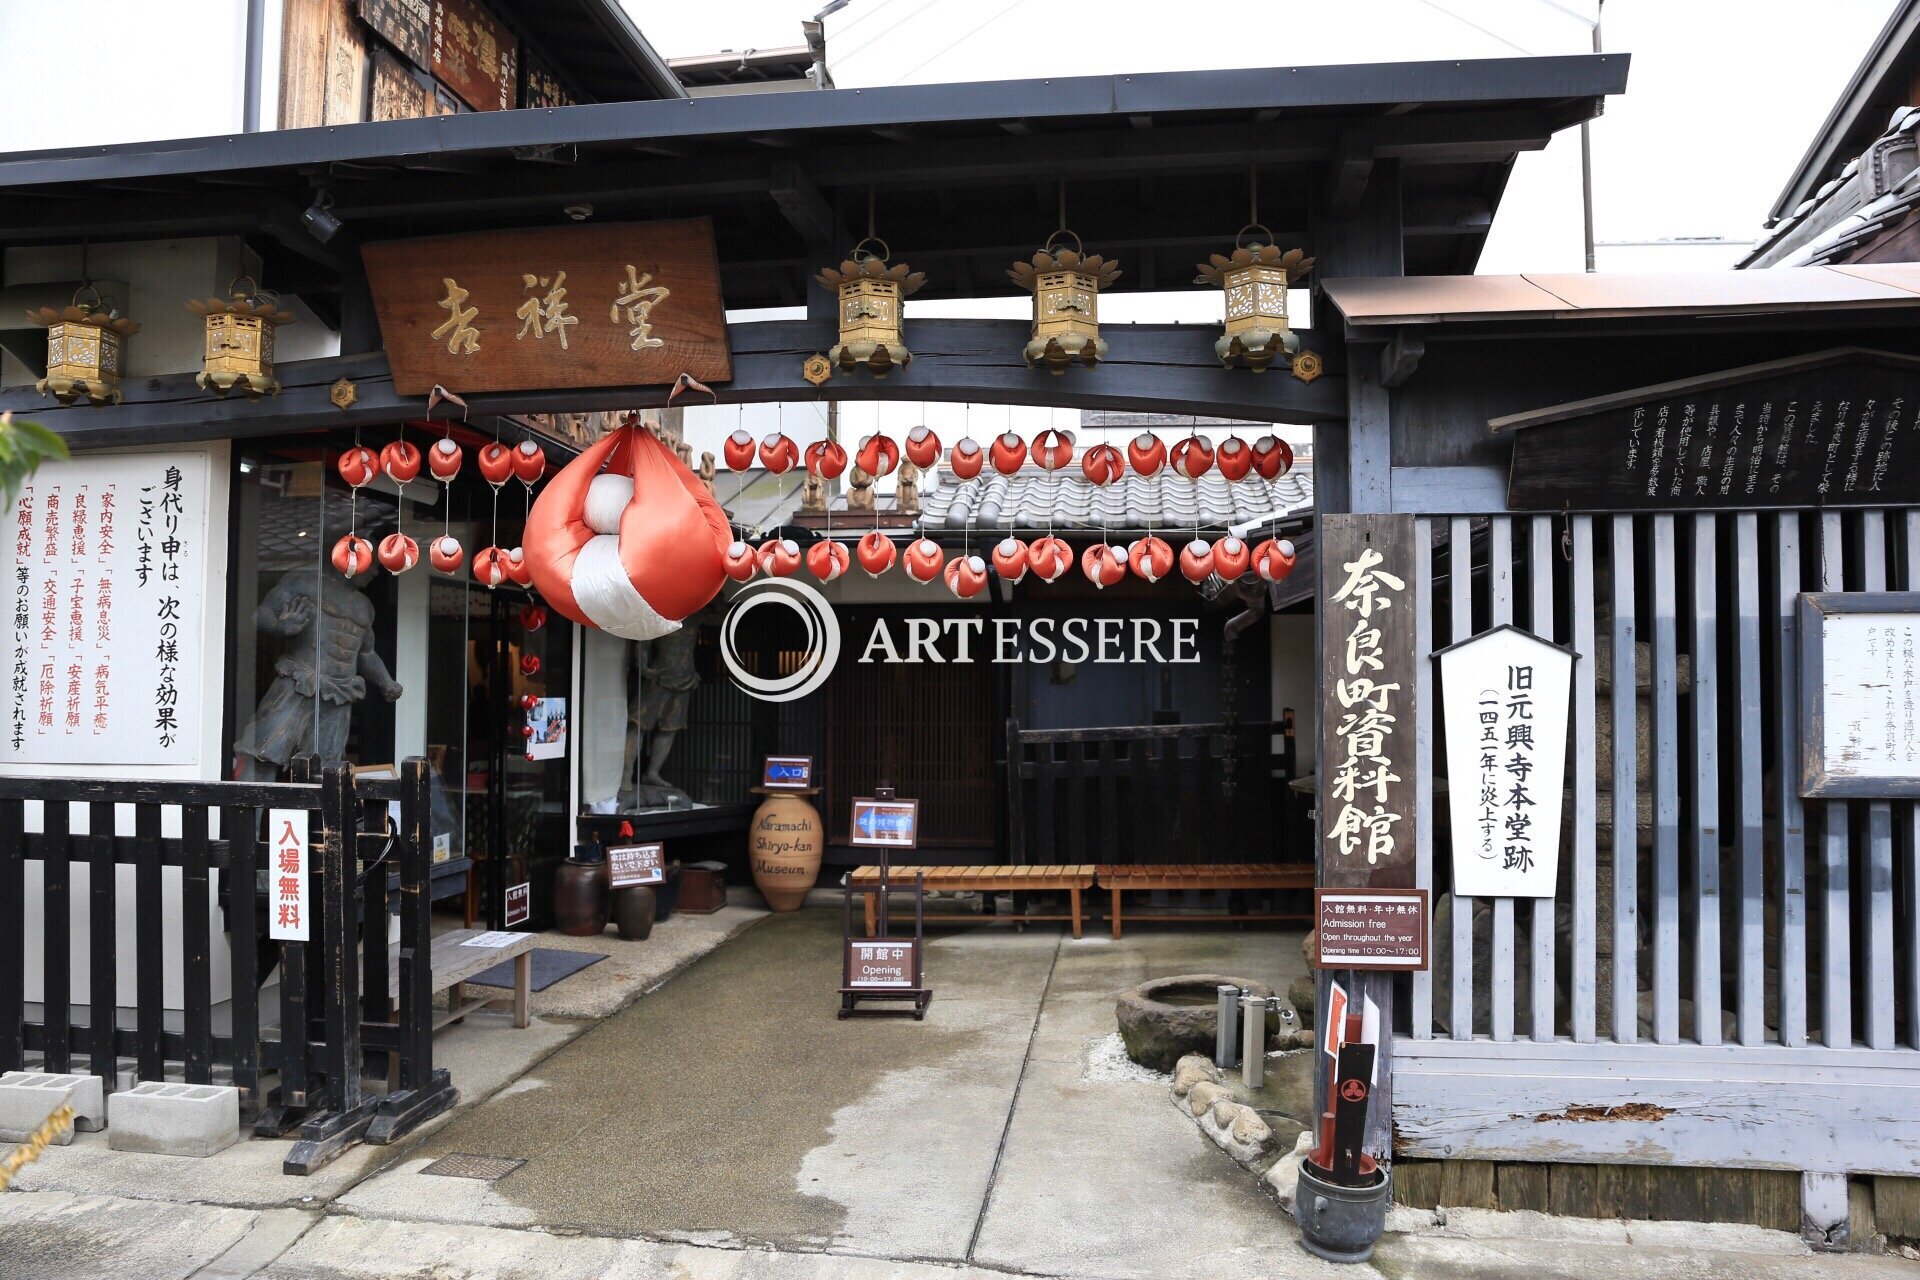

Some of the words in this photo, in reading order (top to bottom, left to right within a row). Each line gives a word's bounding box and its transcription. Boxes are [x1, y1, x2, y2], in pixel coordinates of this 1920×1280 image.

[430, 264, 671, 356] 吉祥堂
[134, 486, 156, 588] ございます
[1327, 547, 1406, 866] 奈良町資料館
[1502, 664, 1537, 873] 旧元興寺本堂跡
[757, 814, 812, 832] Naramachi
[756, 837, 812, 855] Shiryo-kan
[278, 820, 300, 929] 入場無料
[1323, 919, 1365, 929] Admission
[1369, 919, 1387, 929] free
[1322, 933, 1341, 942] Open
[1344, 933, 1381, 943] throughout
[1385, 933, 1396, 942] the
[1398, 935, 1414, 943] year
[861, 947, 904, 960] 開館中
[1322, 947, 1346, 955] Opening
[862, 965, 902, 976] Opening
